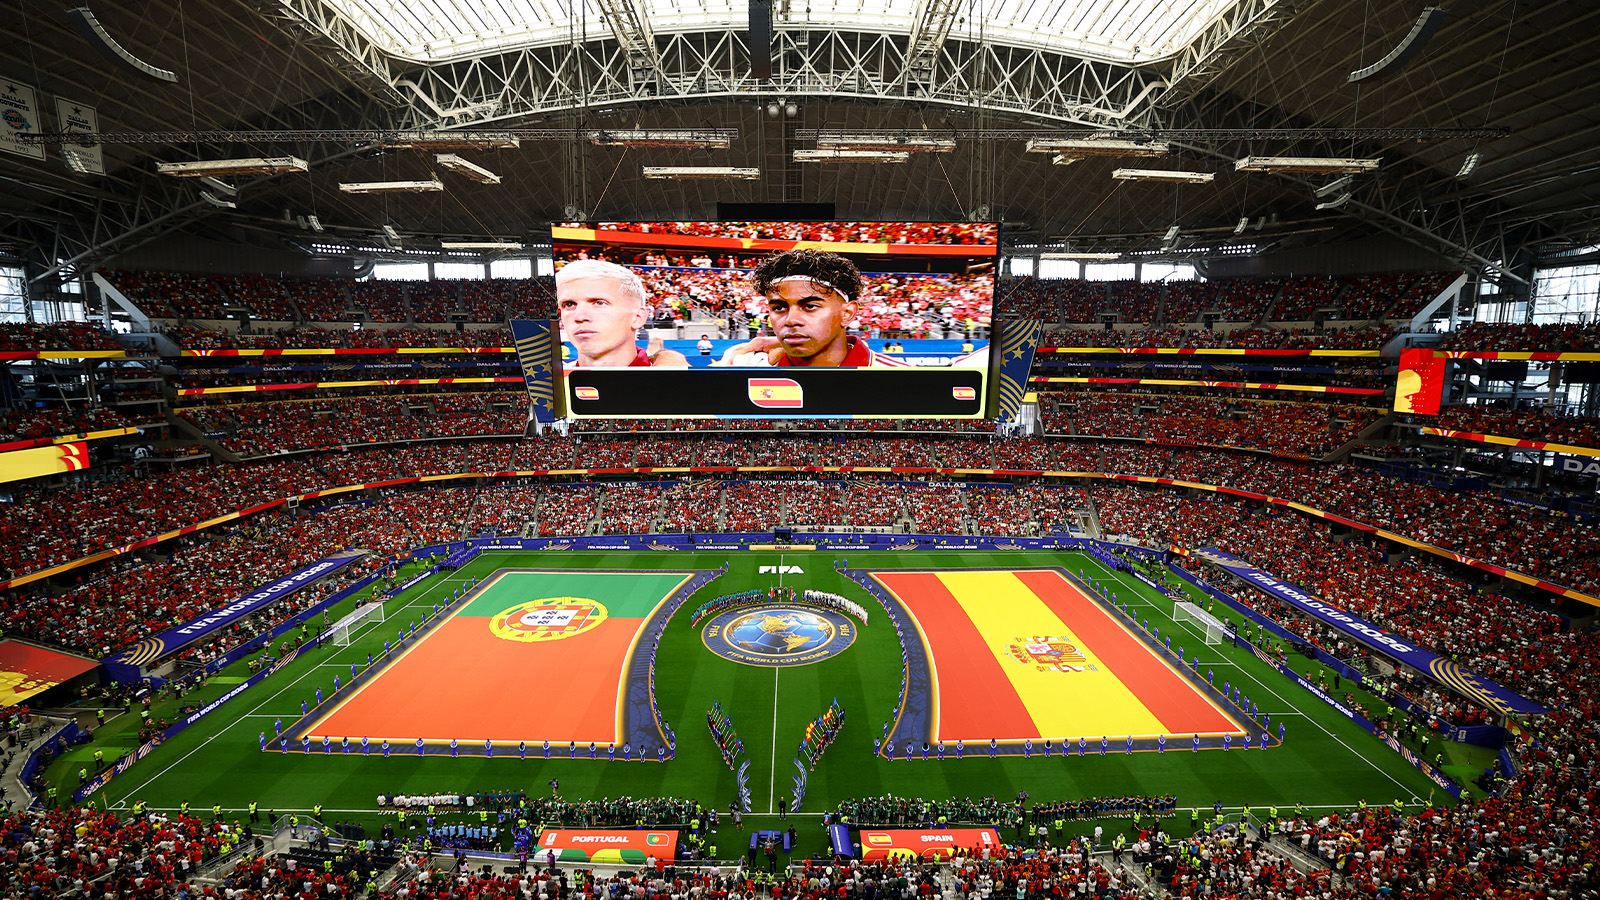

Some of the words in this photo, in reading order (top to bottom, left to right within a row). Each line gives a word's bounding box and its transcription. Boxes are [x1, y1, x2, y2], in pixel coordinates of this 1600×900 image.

[758, 566, 804, 574] FIFA
[177, 617, 222, 634] FIFA
[213, 592, 270, 616] WORLD
[267, 580, 294, 594] CUP
[292, 562, 334, 581] 2026
[1248, 572, 1277, 585] FIFA
[1274, 584, 1324, 608] WORLD
[1318, 606, 1353, 623] CUP
[1349, 622, 1413, 652] 2026
[708, 625, 720, 637] FIFA
[839, 624, 850, 636] FIFA
[727, 651, 744, 659] FIFA
[800, 650, 829, 661] 2026
[187, 713, 200, 724] FIFA
[200, 700, 220, 715] WORLD
[220, 694, 230, 703] CUP
[230, 683, 248, 697] 2026
[1298, 678, 1308, 688] FIFA
[1308, 684, 1325, 699] WORLD
[1324, 696, 1335, 705] CUP
[1335, 703, 1353, 718] 2026
